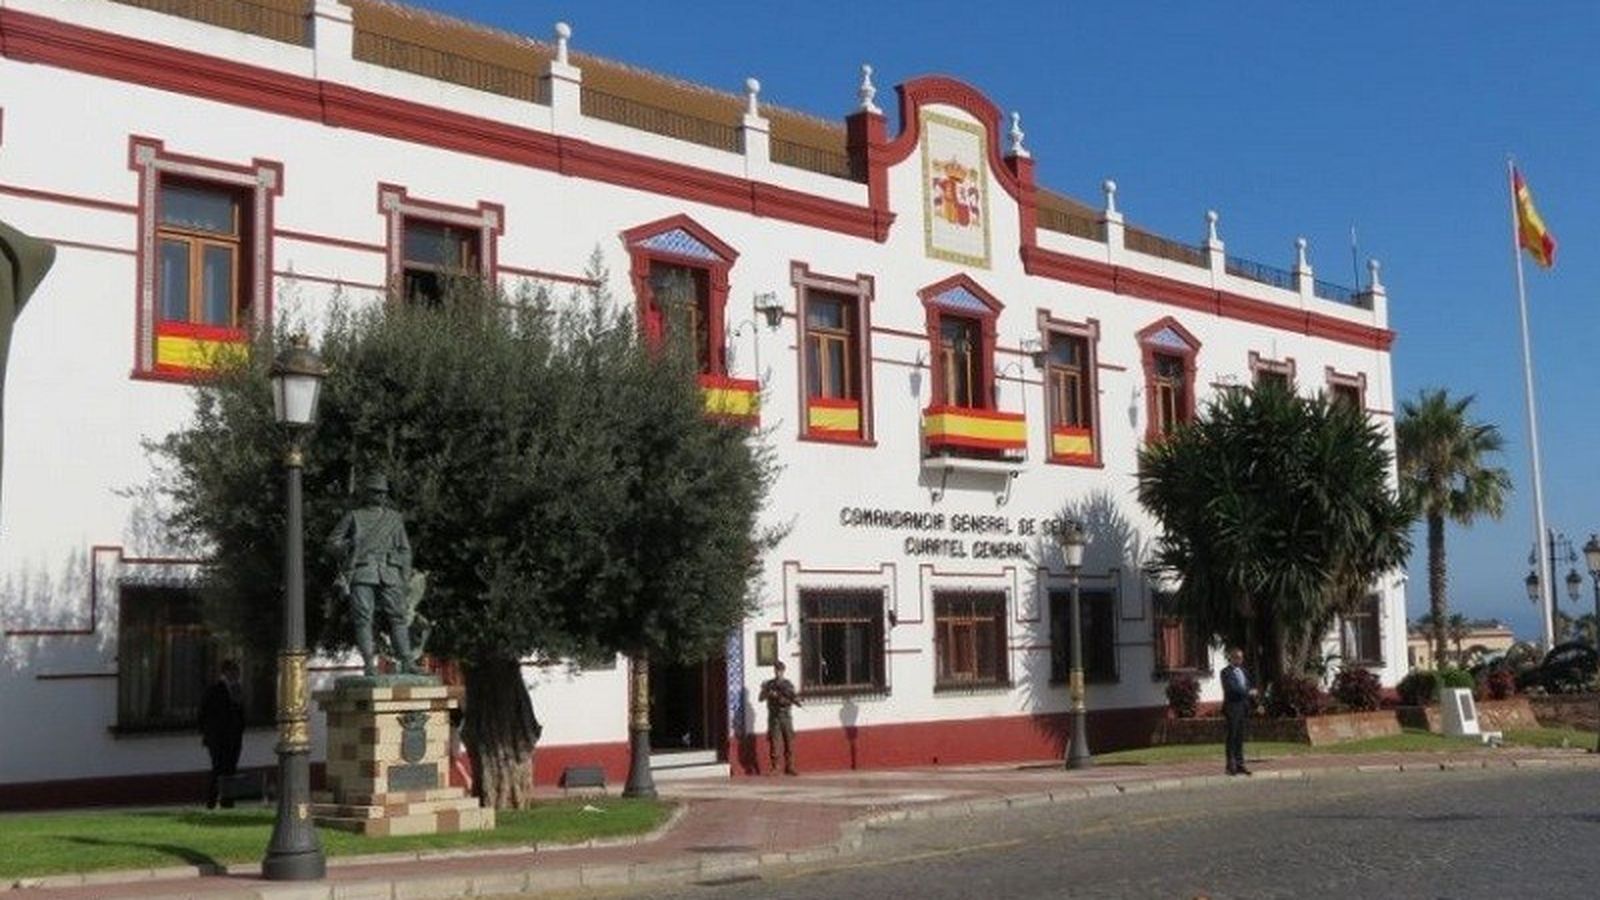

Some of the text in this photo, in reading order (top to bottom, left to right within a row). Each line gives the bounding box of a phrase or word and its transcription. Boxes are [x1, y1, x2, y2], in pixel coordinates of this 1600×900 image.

[840, 507, 945, 531] COMANDANCIA
[951, 513, 1013, 535] GENERAL
[1018, 518, 1036, 537] DE
[905, 536, 1030, 560] CUARTEL GENERAL
